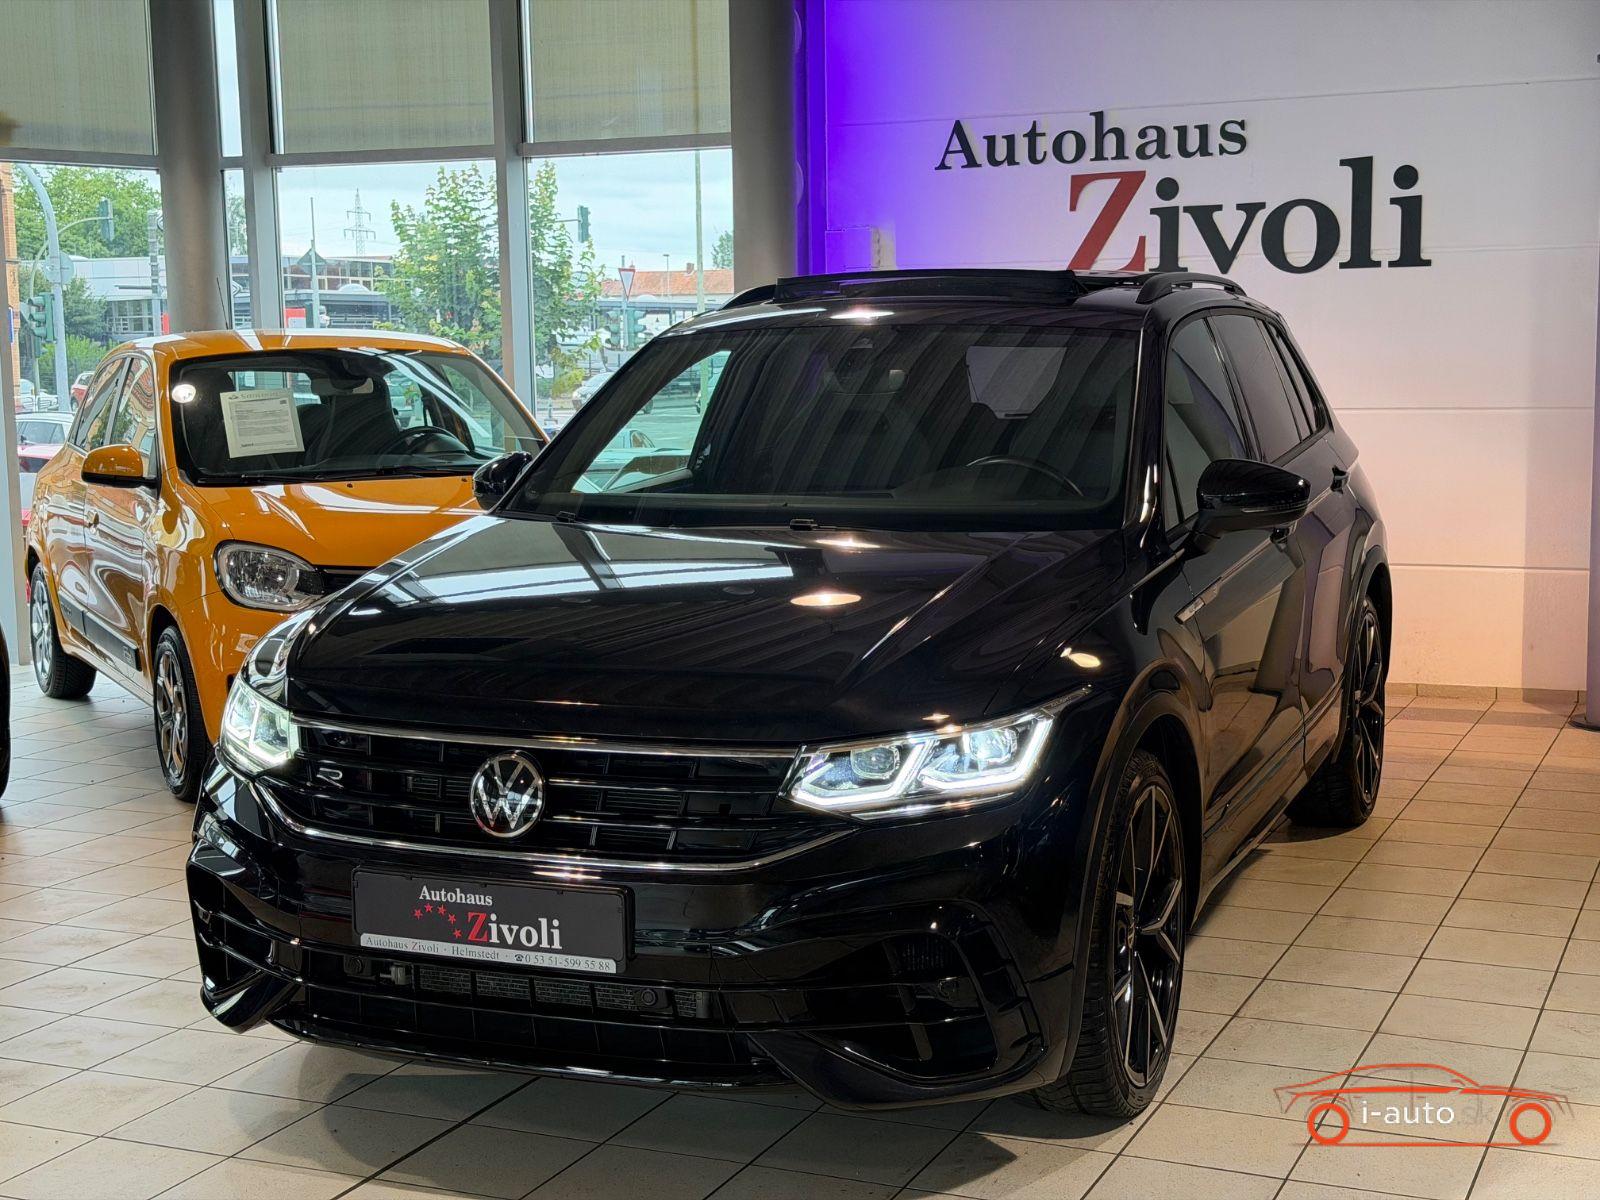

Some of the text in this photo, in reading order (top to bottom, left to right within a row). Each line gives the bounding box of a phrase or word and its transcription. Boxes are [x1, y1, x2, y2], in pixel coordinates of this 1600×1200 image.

[935, 110, 1248, 171] Autohaus
[1067, 155, 1432, 275] Zivoli
[418, 884, 493, 906] Autohaus
[366, 936, 409, 950] Autohaus
[411, 941, 439, 953] Zivoli
[451, 945, 500, 960] Helmstedt
[466, 911, 563, 950] Zivoli
